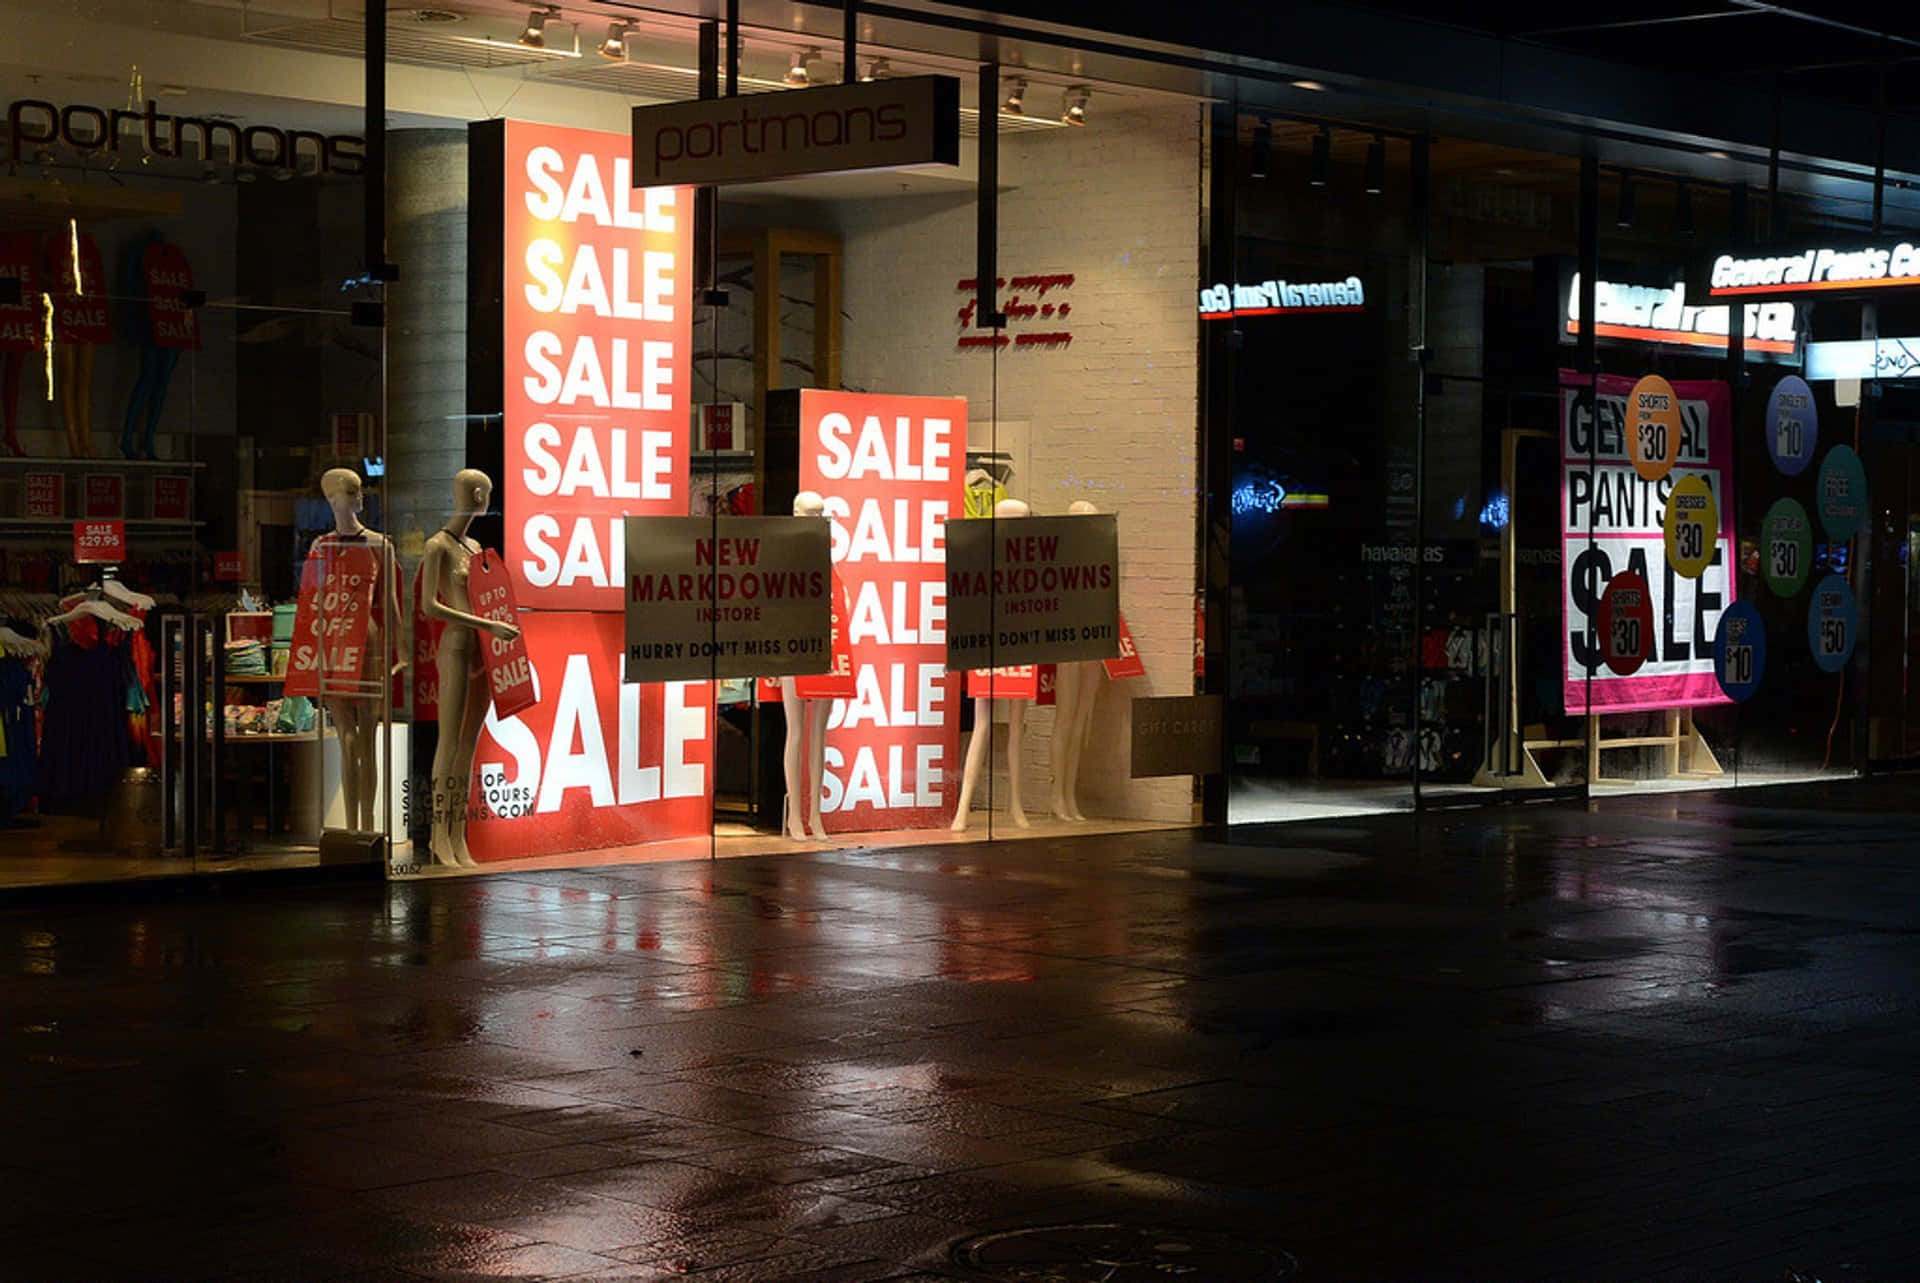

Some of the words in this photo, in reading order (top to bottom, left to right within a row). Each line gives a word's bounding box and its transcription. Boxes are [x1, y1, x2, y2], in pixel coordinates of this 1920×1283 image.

[11, 100, 367, 176] portmans
[654, 102, 907, 177] portmans
[524, 146, 676, 233] SALE
[523, 238, 676, 322] SALE
[1711, 254, 1816, 289] General
[523, 330, 674, 411] SALE
[816, 412, 953, 482] SALE
[1638, 424, 1668, 461] $30
[1777, 420, 1802, 456] $10
[522, 422, 673, 500] SALE
[1569, 471, 1674, 528] PANTS
[78, 534, 121, 548] $29.95
[86, 523, 113, 536] SALE
[1675, 522, 1703, 559] $30
[695, 538, 760, 566] NEW
[1005, 535, 1060, 562] NEW
[1771, 542, 1797, 577] $30
[340, 573, 361, 587] TO
[631, 570, 824, 603] MARKDOWNS
[950, 563, 1112, 598] MARKDOWNS
[696, 606, 762, 623] INSTORE
[1004, 597, 1060, 616] INSTORE
[309, 617, 356, 638] OFF
[949, 630, 993, 651] HURRY
[999, 628, 1040, 648] DON'T
[1045, 626, 1077, 643] MISS
[1081, 623, 1112, 641] OUT!
[1611, 618, 1639, 656] $30
[293, 645, 359, 672] SALE
[630, 641, 685, 661] HURRY
[689, 638, 739, 659] DON'T
[744, 638, 781, 657] MISS
[788, 637, 824, 655] OUT!
[1727, 645, 1752, 682] $10
[491, 655, 530, 695] SALE
[481, 652, 709, 820] SALE
[819, 744, 945, 814] SALE
